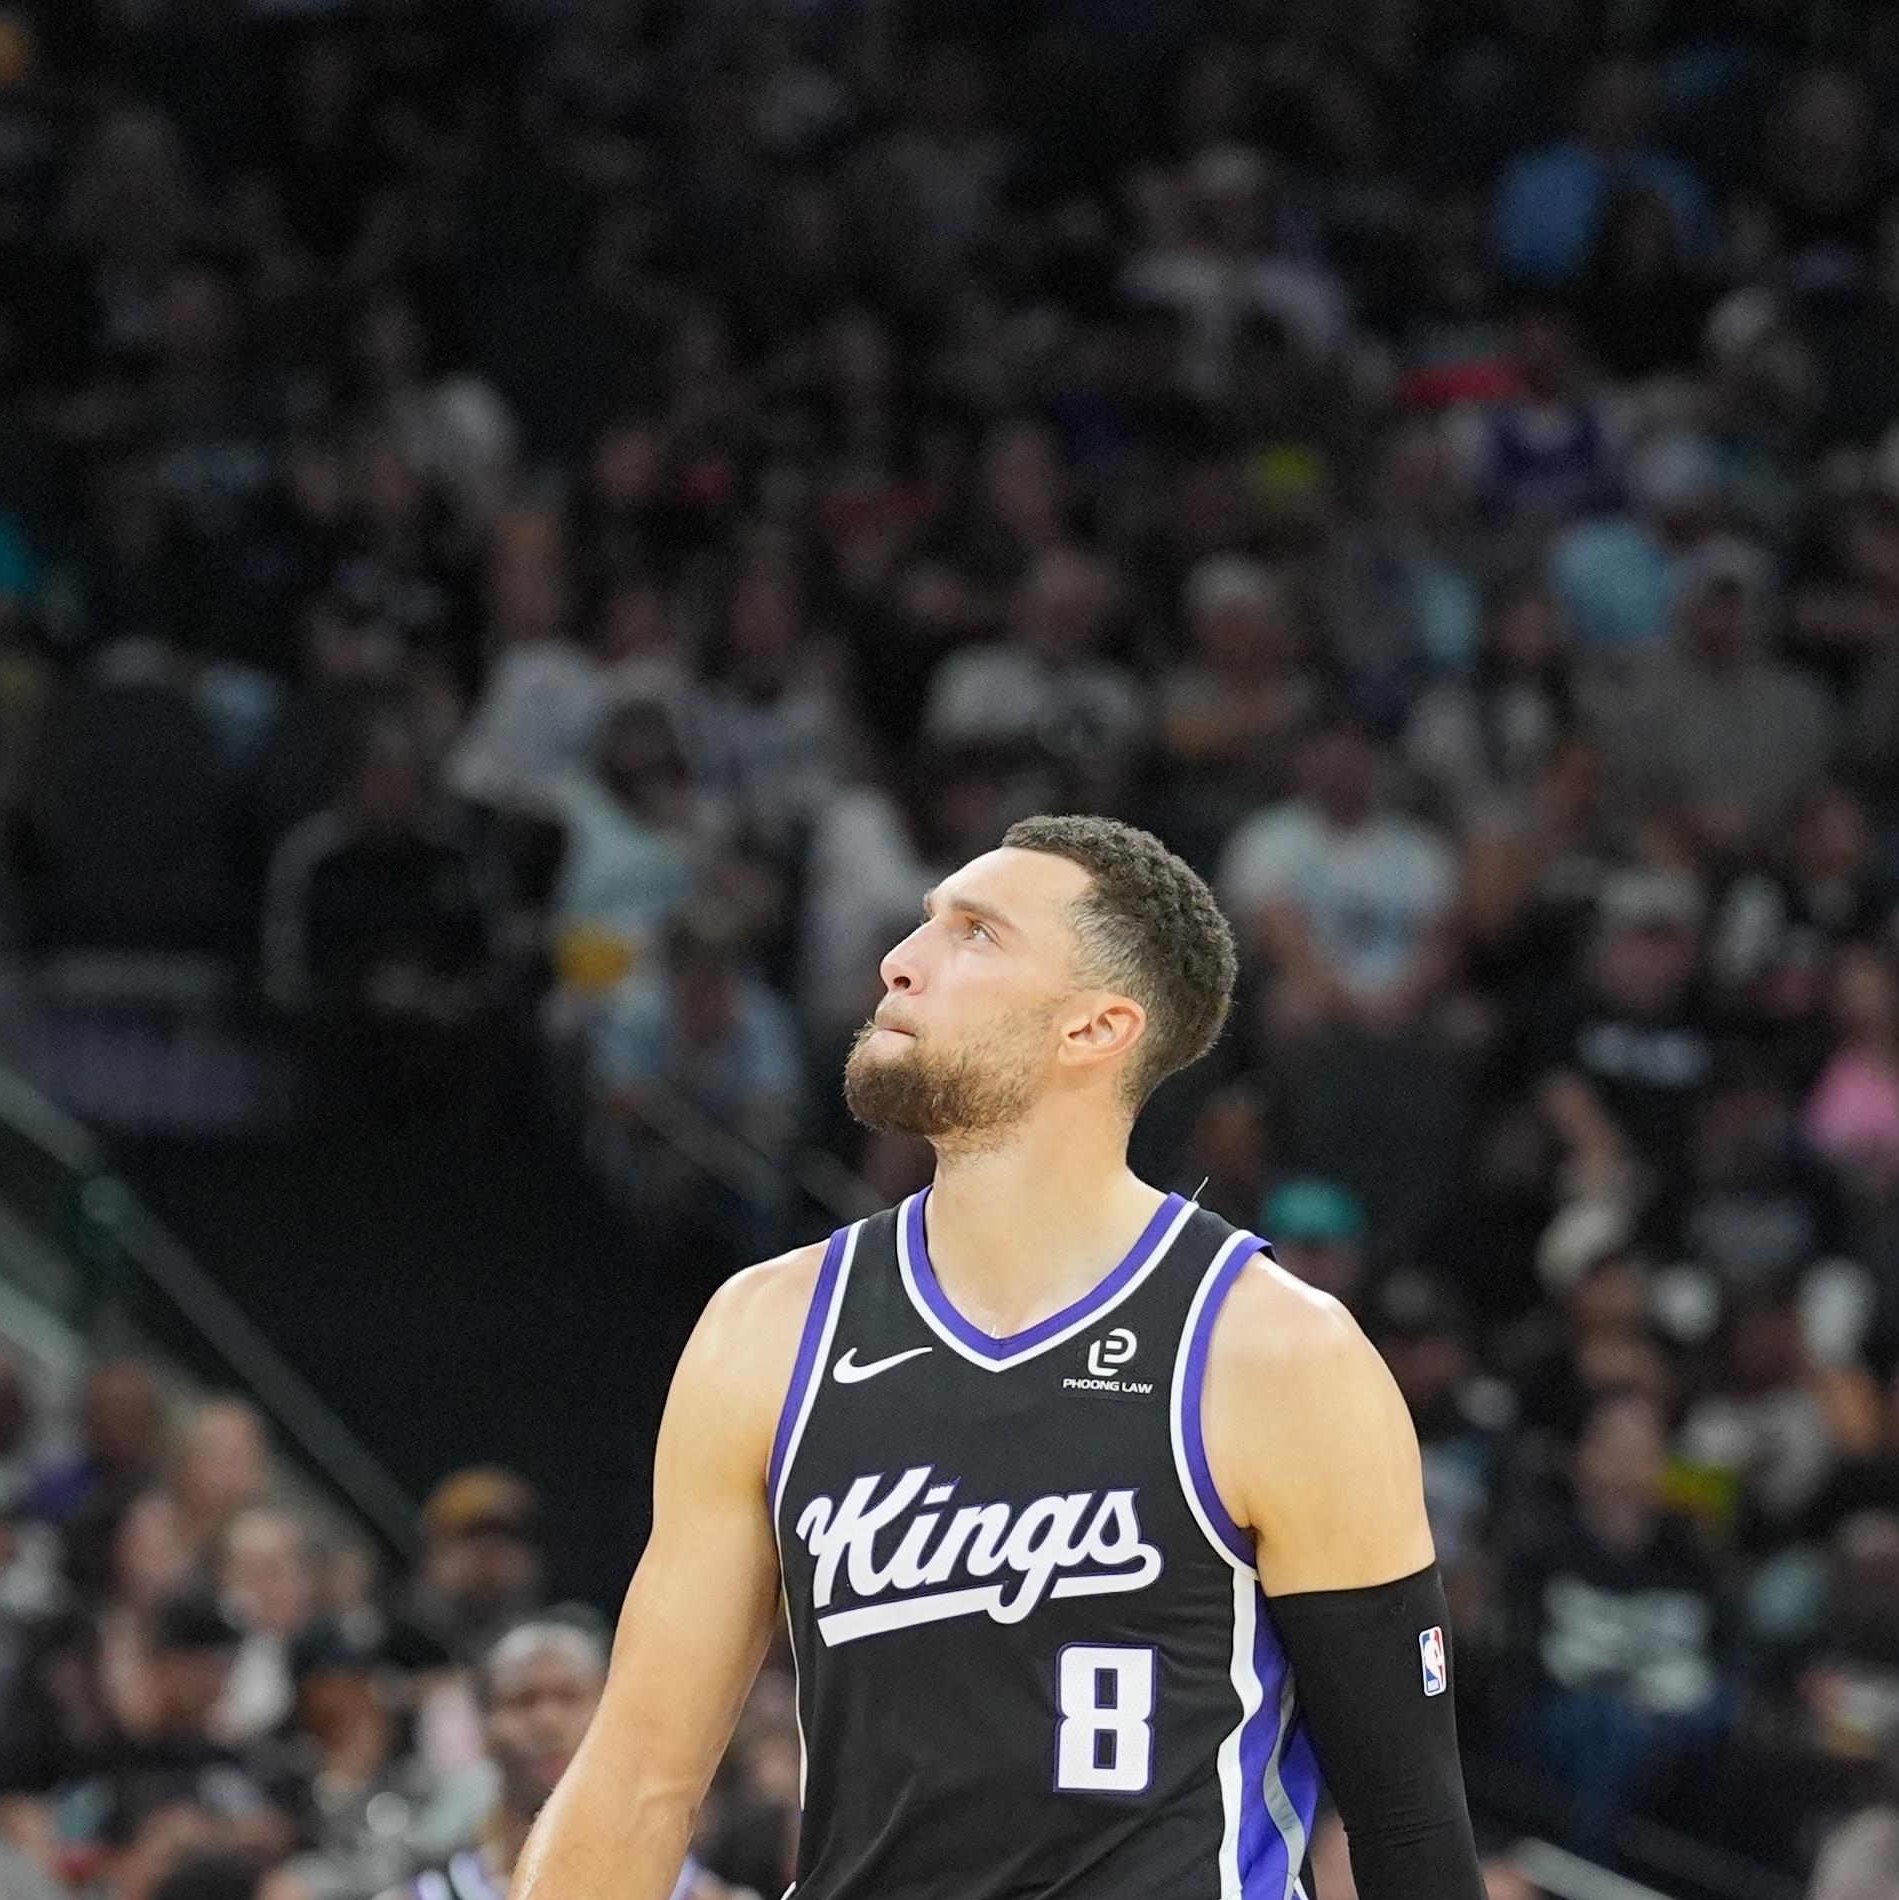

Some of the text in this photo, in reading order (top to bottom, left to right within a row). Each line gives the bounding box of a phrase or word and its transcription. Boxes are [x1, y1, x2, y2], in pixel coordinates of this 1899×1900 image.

[1062, 1378, 1153, 1394] PHOONG LAW
[795, 1464, 1164, 1648] Kings
[1053, 1641, 1159, 1793] 8
